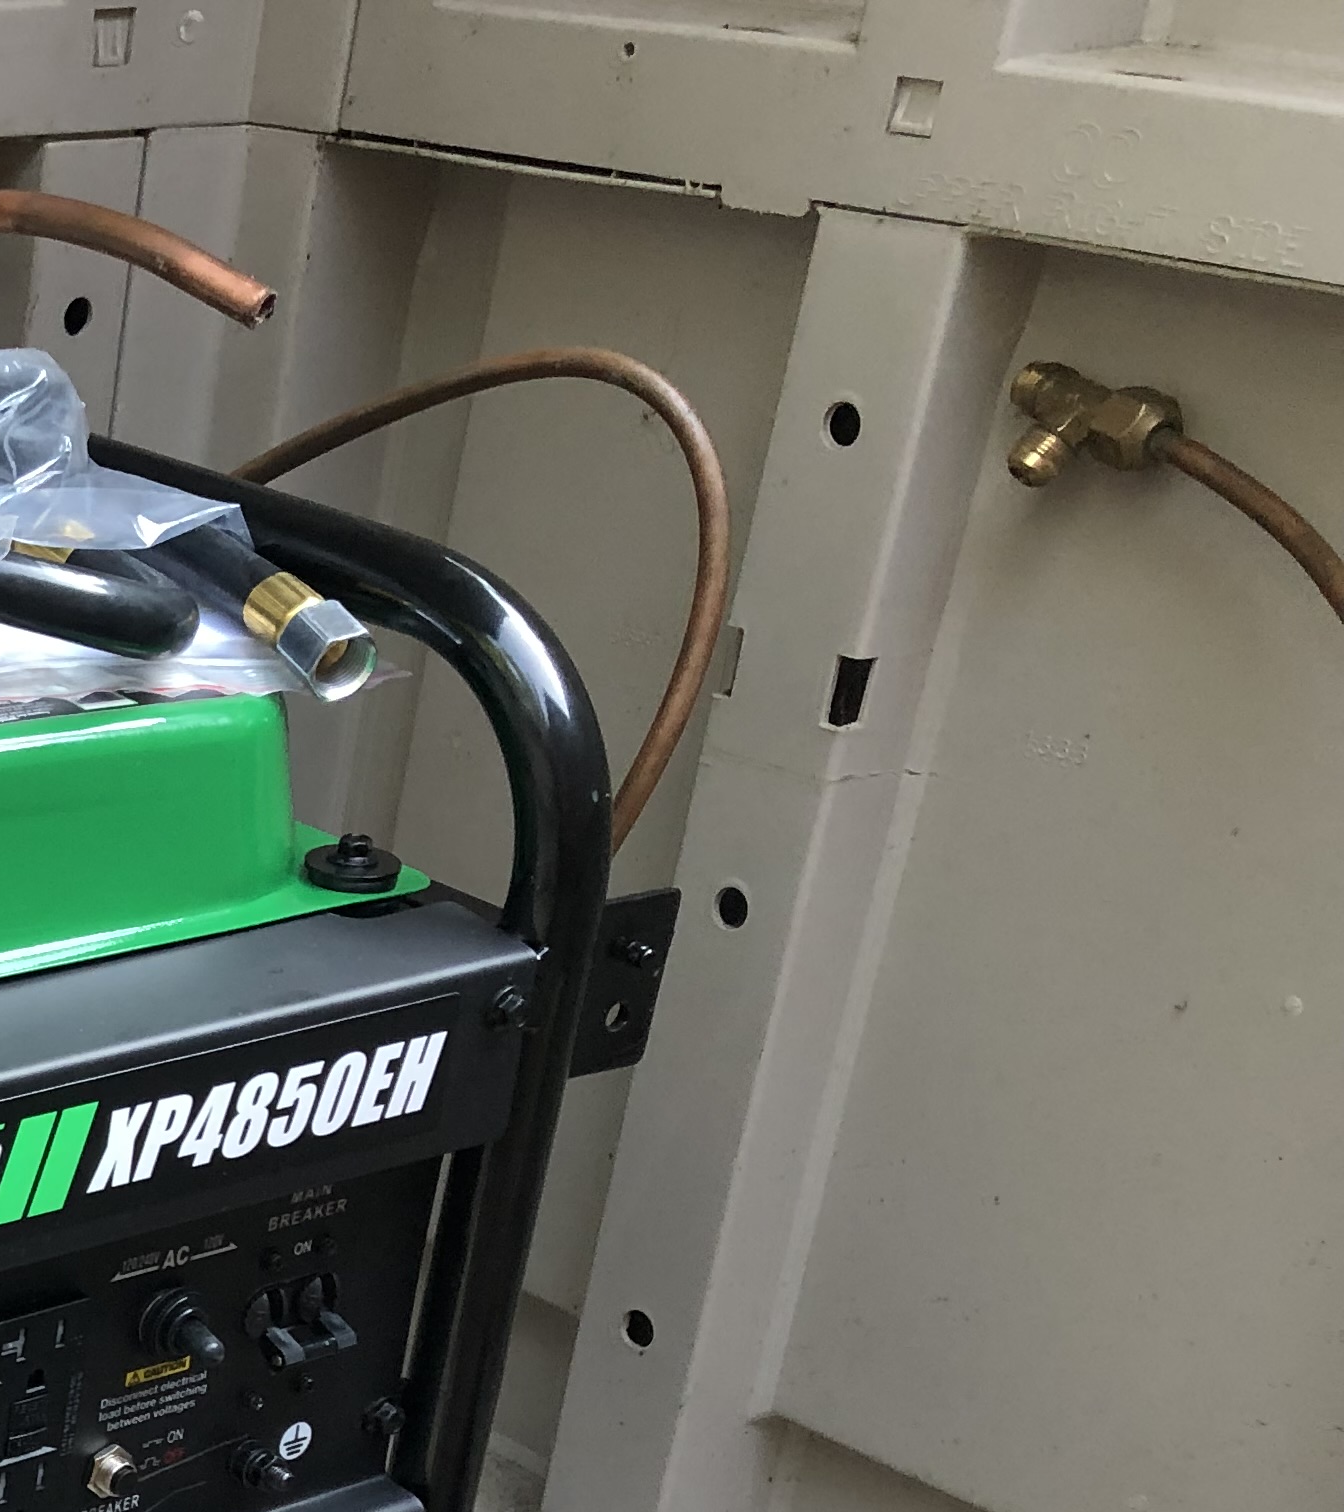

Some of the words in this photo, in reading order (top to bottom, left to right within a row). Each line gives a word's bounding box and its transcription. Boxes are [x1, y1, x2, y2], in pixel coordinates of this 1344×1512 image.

[87, 1031, 447, 1194] XP4850EH
[268, 1198, 346, 1231] BREAKER
[162, 1246, 190, 1269] AC
[294, 1240, 311, 1255] ON
[167, 1428, 183, 1442] ON
